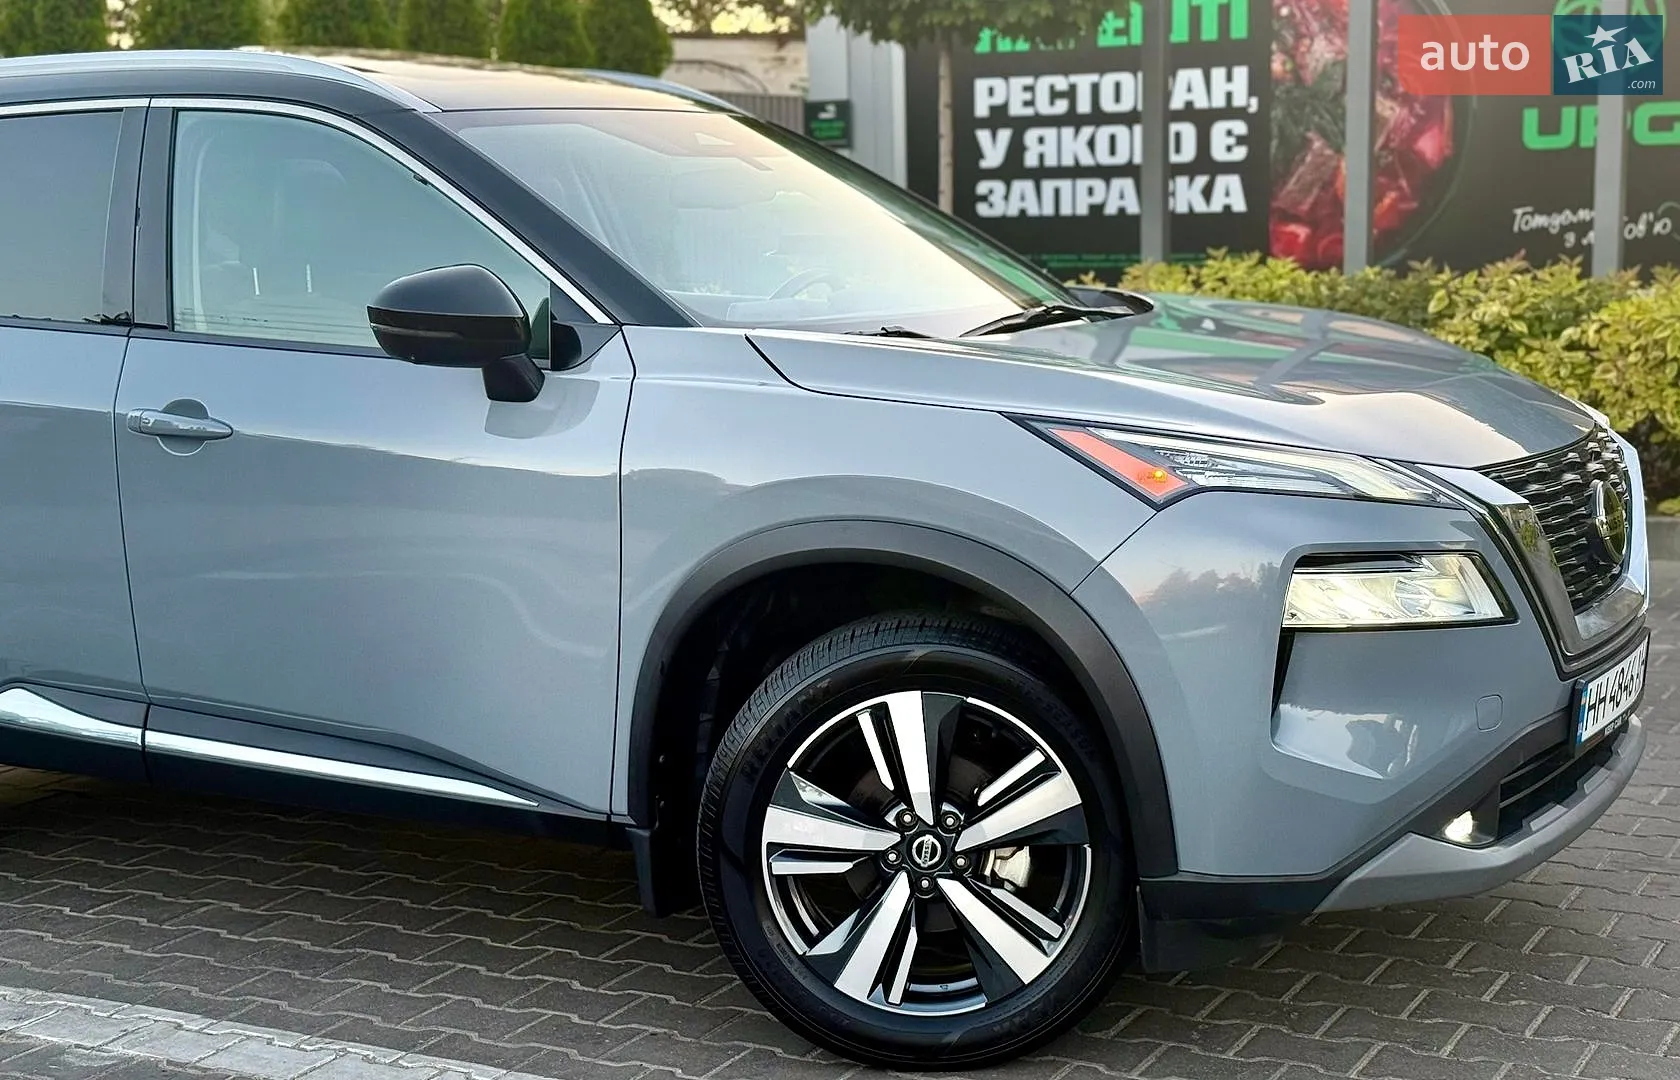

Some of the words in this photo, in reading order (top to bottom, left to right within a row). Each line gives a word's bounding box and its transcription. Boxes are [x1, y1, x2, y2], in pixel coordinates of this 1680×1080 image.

[973, 65, 1259, 118] РЕСТОАН,
[975, 127, 1013, 169] У
[1209, 119, 1249, 163] Є
[975, 173, 1248, 218] ЗАПРАКА
